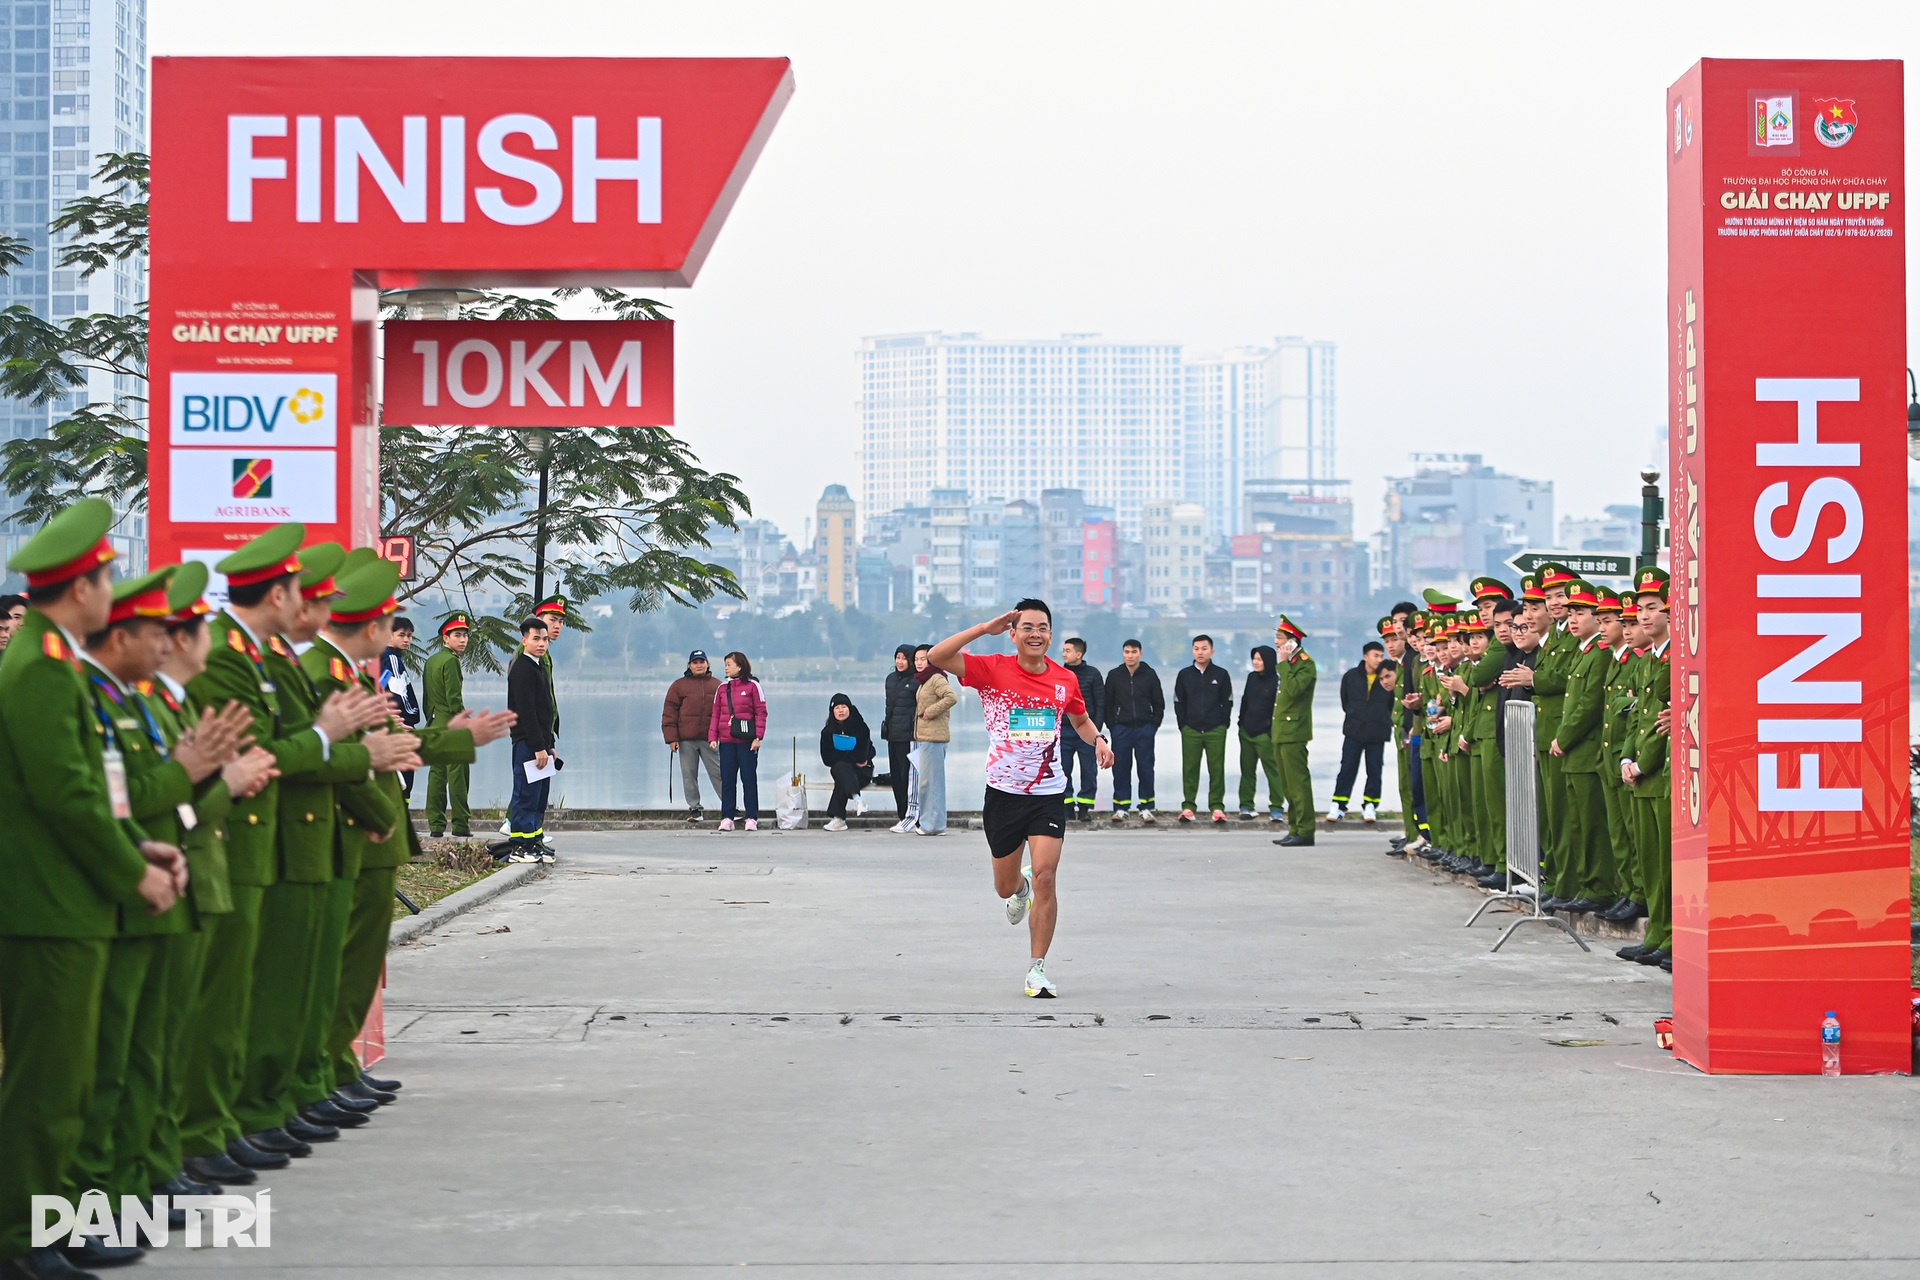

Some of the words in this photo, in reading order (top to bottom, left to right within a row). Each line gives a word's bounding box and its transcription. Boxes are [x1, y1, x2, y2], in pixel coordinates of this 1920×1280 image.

[227, 114, 662, 226] FINISH
[1722, 177, 1757, 185] TRƯỜNG
[1758, 177, 1771, 186] ĐẠI
[1773, 178, 1789, 186] HỌC
[1791, 177, 1818, 186] PHÒNG
[1820, 177, 1841, 186] CHÁY
[1842, 177, 1865, 186] CHỮA
[1866, 177, 1887, 186] CHÁY
[1781, 168, 1792, 177] BỘ
[1794, 168, 1816, 177] CÔNG
[1818, 169, 1829, 177] AN
[1720, 187, 1769, 210] GIẢI
[1773, 192, 1833, 213] CHẠY
[1837, 192, 1890, 210] UFPF
[172, 319, 221, 343] GIẢI
[223, 325, 283, 346] CHẠY
[285, 325, 339, 344] UFPF
[413, 339, 643, 410] 10KM
[1686, 289, 1699, 455] UFPF
[183, 394, 288, 433] BIDV
[215, 506, 291, 517] AGRIBANK
[1673, 487, 1680, 518] AN
[1582, 561, 1595, 572] EM
[1687, 471, 1700, 657] CHẠY
[1753, 377, 1864, 812] FINISH
[1027, 717, 1046, 727] 1115
[1685, 675, 1700, 826] GIẢI
